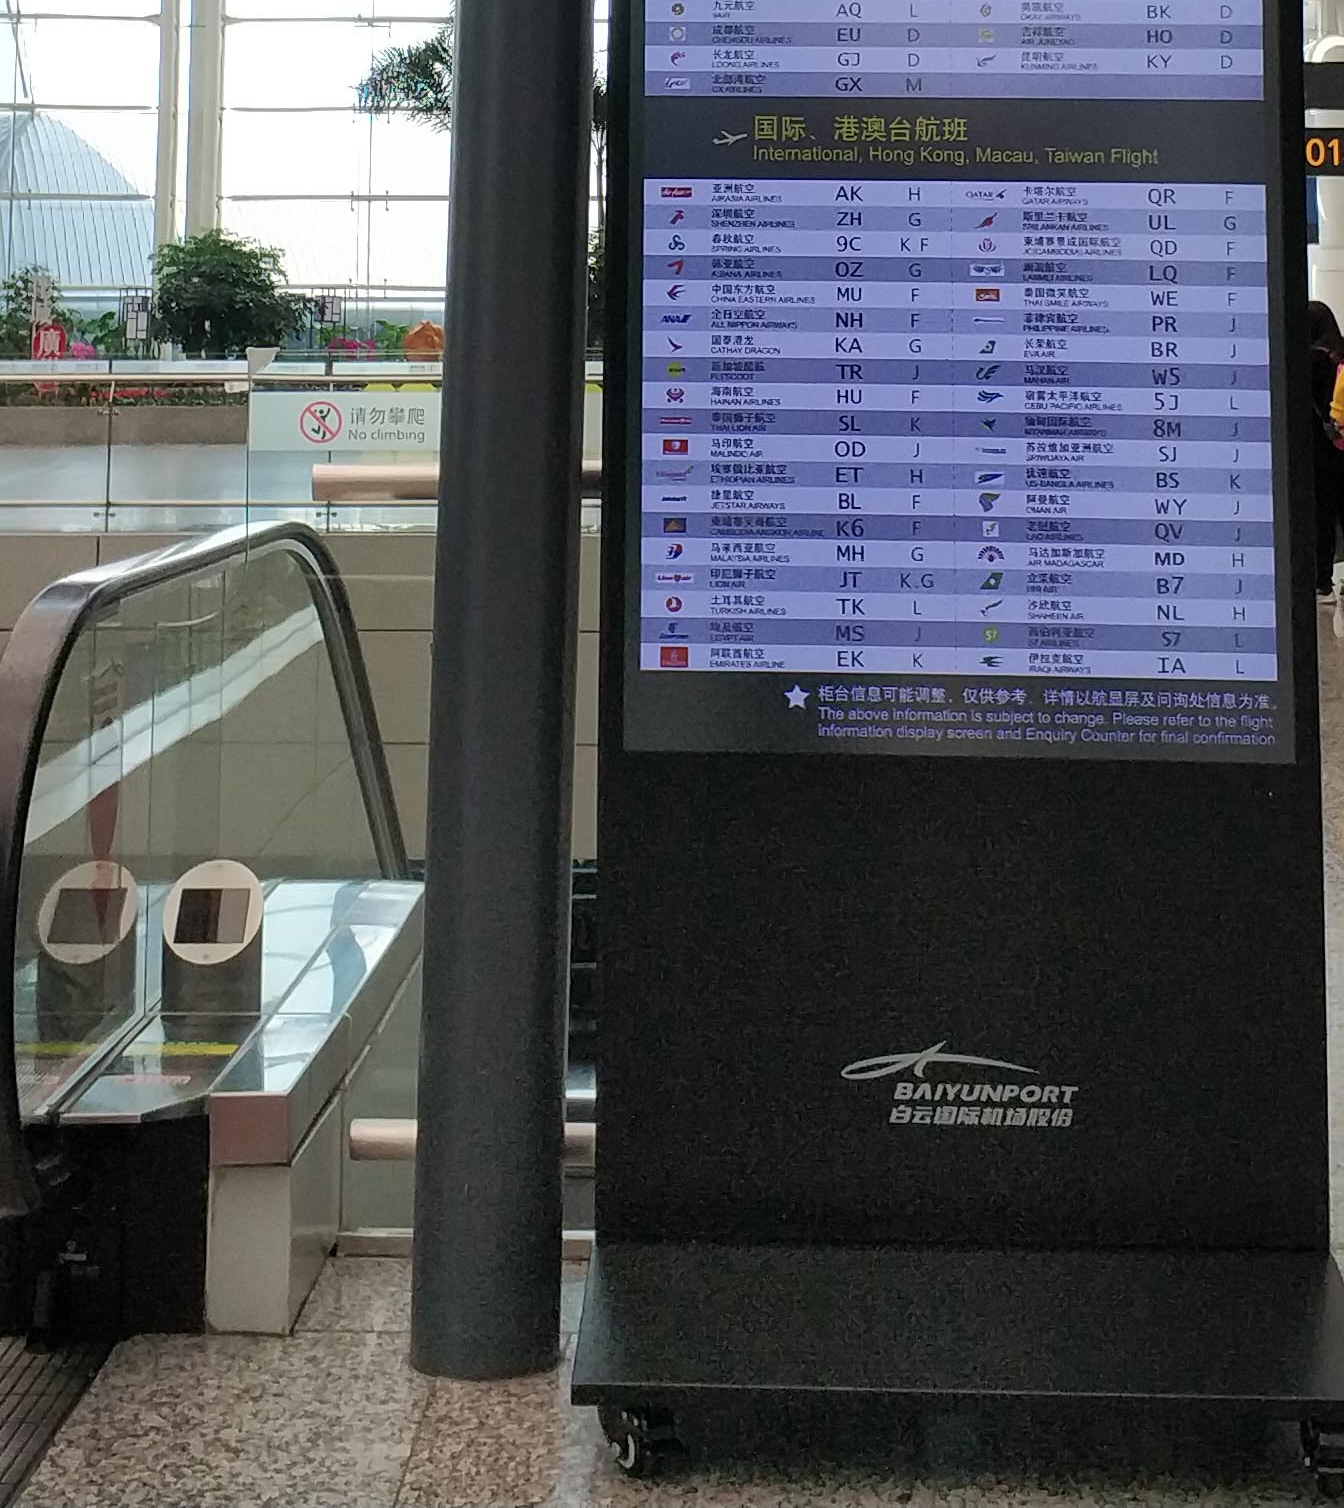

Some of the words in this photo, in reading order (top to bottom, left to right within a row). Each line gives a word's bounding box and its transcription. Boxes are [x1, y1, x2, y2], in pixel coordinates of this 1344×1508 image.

[836, 2, 862, 19] AQ
[1146, 5, 1173, 19] BK
[837, 28, 862, 42] EU
[837, 53, 860, 67] GJ
[1145, 55, 1173, 69] KY
[835, 77, 863, 92] GX
[753, 146, 861, 164] International,
[869, 147, 916, 166] Hong
[920, 147, 969, 167] Kong,
[976, 148, 1038, 167] Macau,
[1045, 148, 1104, 165] Taiwan
[1112, 148, 1159, 168] Flight
[835, 186, 864, 202] AK
[1147, 189, 1176, 206] QR
[837, 212, 862, 226] ZH
[1148, 215, 1176, 230] UL
[836, 236, 862, 252] 9C
[1149, 240, 1177, 256] QD
[1149, 265, 1178, 284] LQ
[836, 288, 862, 302] MU
[1150, 291, 1179, 306] WE
[835, 312, 864, 328] NH
[1151, 316, 1177, 333] PR
[835, 338, 864, 353] KA
[1151, 341, 1179, 358] BR
[836, 364, 864, 380] TR
[1152, 368, 1181, 386] W5
[837, 390, 862, 404] HU
[349, 406, 425, 426] 请勿攀爬
[838, 416, 861, 432] SL
[348, 429, 367, 441] No
[371, 428, 425, 444] climbing
[1152, 418, 1182, 438] 8M
[834, 442, 866, 458] OD
[1159, 446, 1177, 463] SJ
[835, 467, 864, 484] ET
[1156, 473, 1180, 488] BS
[838, 494, 861, 510] BL
[1154, 498, 1187, 515] WY
[836, 519, 865, 538] K6
[1154, 523, 1183, 540] QV
[836, 546, 865, 562] MH
[1154, 552, 1185, 566] MD
[839, 572, 862, 588] JT
[1156, 577, 1184, 594] B7
[836, 598, 865, 615] TK
[1157, 605, 1185, 621] NL
[835, 625, 865, 642] MS
[837, 651, 865, 668] EK
[818, 707, 844, 720] The
[848, 709, 889, 720] above
[893, 708, 967, 722] information
[971, 710, 982, 722] is
[986, 709, 1034, 726] subject
[1039, 714, 1051, 723] to
[1113, 712, 1159, 726] Please
[1163, 714, 1194, 726] refer
[1198, 715, 1211, 727] to
[1215, 715, 1236, 727] the
[1241, 715, 1273, 731] flight
[817, 724, 892, 738] information
[897, 726, 942, 741] display
[947, 729, 992, 739] screen
[997, 728, 1023, 740] and
[1026, 727, 1076, 743] Enquiry
[1081, 729, 1134, 742] Counter
[1139, 730, 1156, 742] for
[1160, 730, 1188, 743] final
[1193, 731, 1275, 745] confirmation
[893, 1082, 1079, 1104] BAIYUNPORT
[889, 1104, 1074, 1127] 白云国际机场股份
